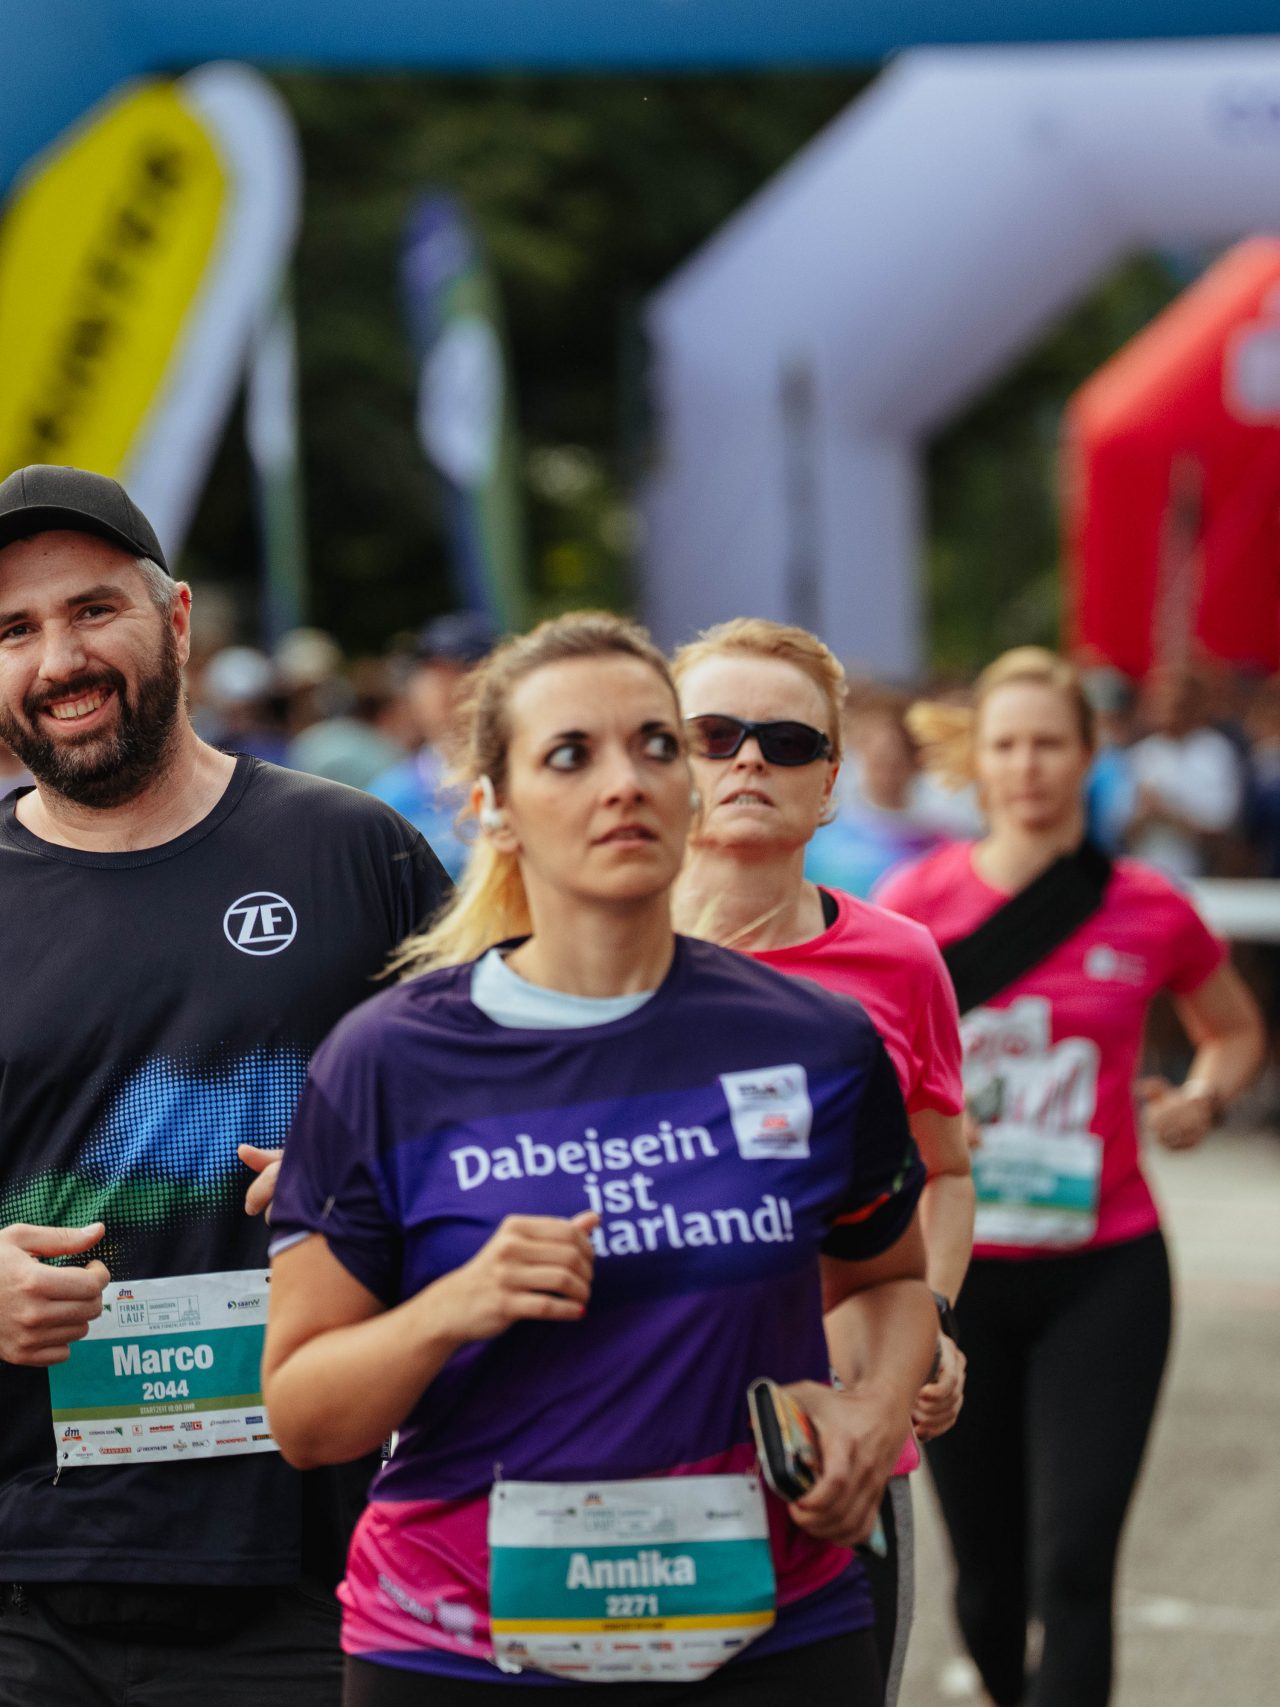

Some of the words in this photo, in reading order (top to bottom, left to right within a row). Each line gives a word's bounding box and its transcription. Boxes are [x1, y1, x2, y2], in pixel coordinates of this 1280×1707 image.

[226, 898, 295, 948] ZF
[450, 1120, 719, 1192] Dabeisein
[583, 1172, 658, 1215] ist
[591, 1194, 794, 1257] arland!
[112, 1344, 214, 1377] Marco
[142, 1379, 189, 1400] 2044
[64, 1427, 80, 1438] dm
[566, 1550, 697, 1590] Annika
[605, 1594, 660, 1617] 2271
